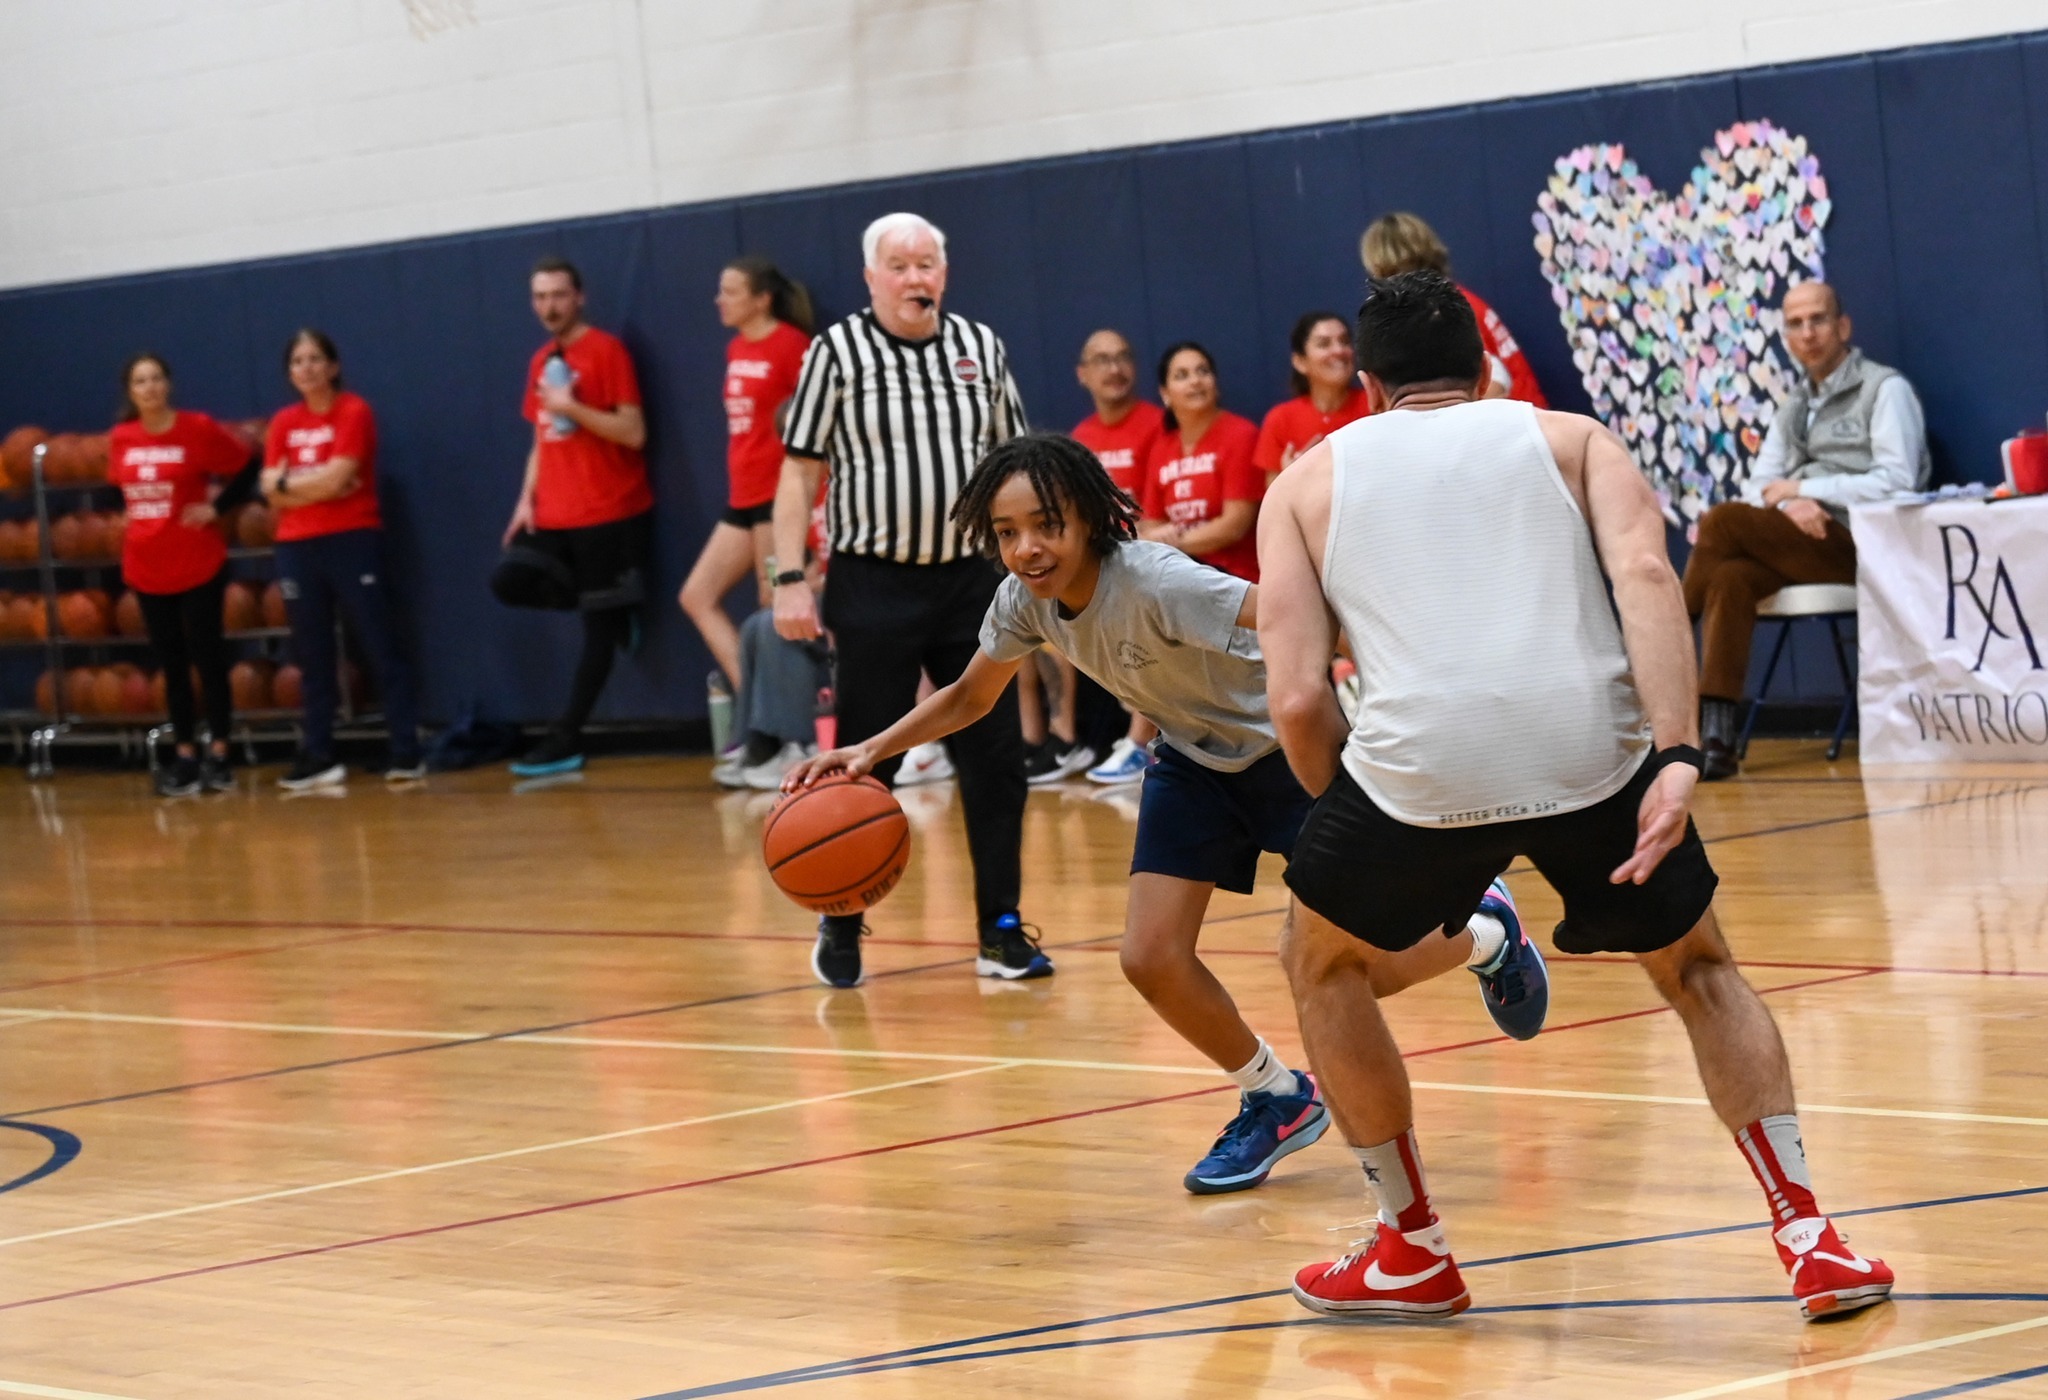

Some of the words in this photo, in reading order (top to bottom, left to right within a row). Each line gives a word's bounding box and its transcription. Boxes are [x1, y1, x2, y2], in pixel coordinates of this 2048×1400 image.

[1908, 691, 2048, 745] PATRIO
[1440, 809, 1489, 824] BETTER
[1496, 805, 1528, 818] EACH
[1535, 801, 1557, 813] DAY
[1791, 1230, 1811, 1244] NIKE
